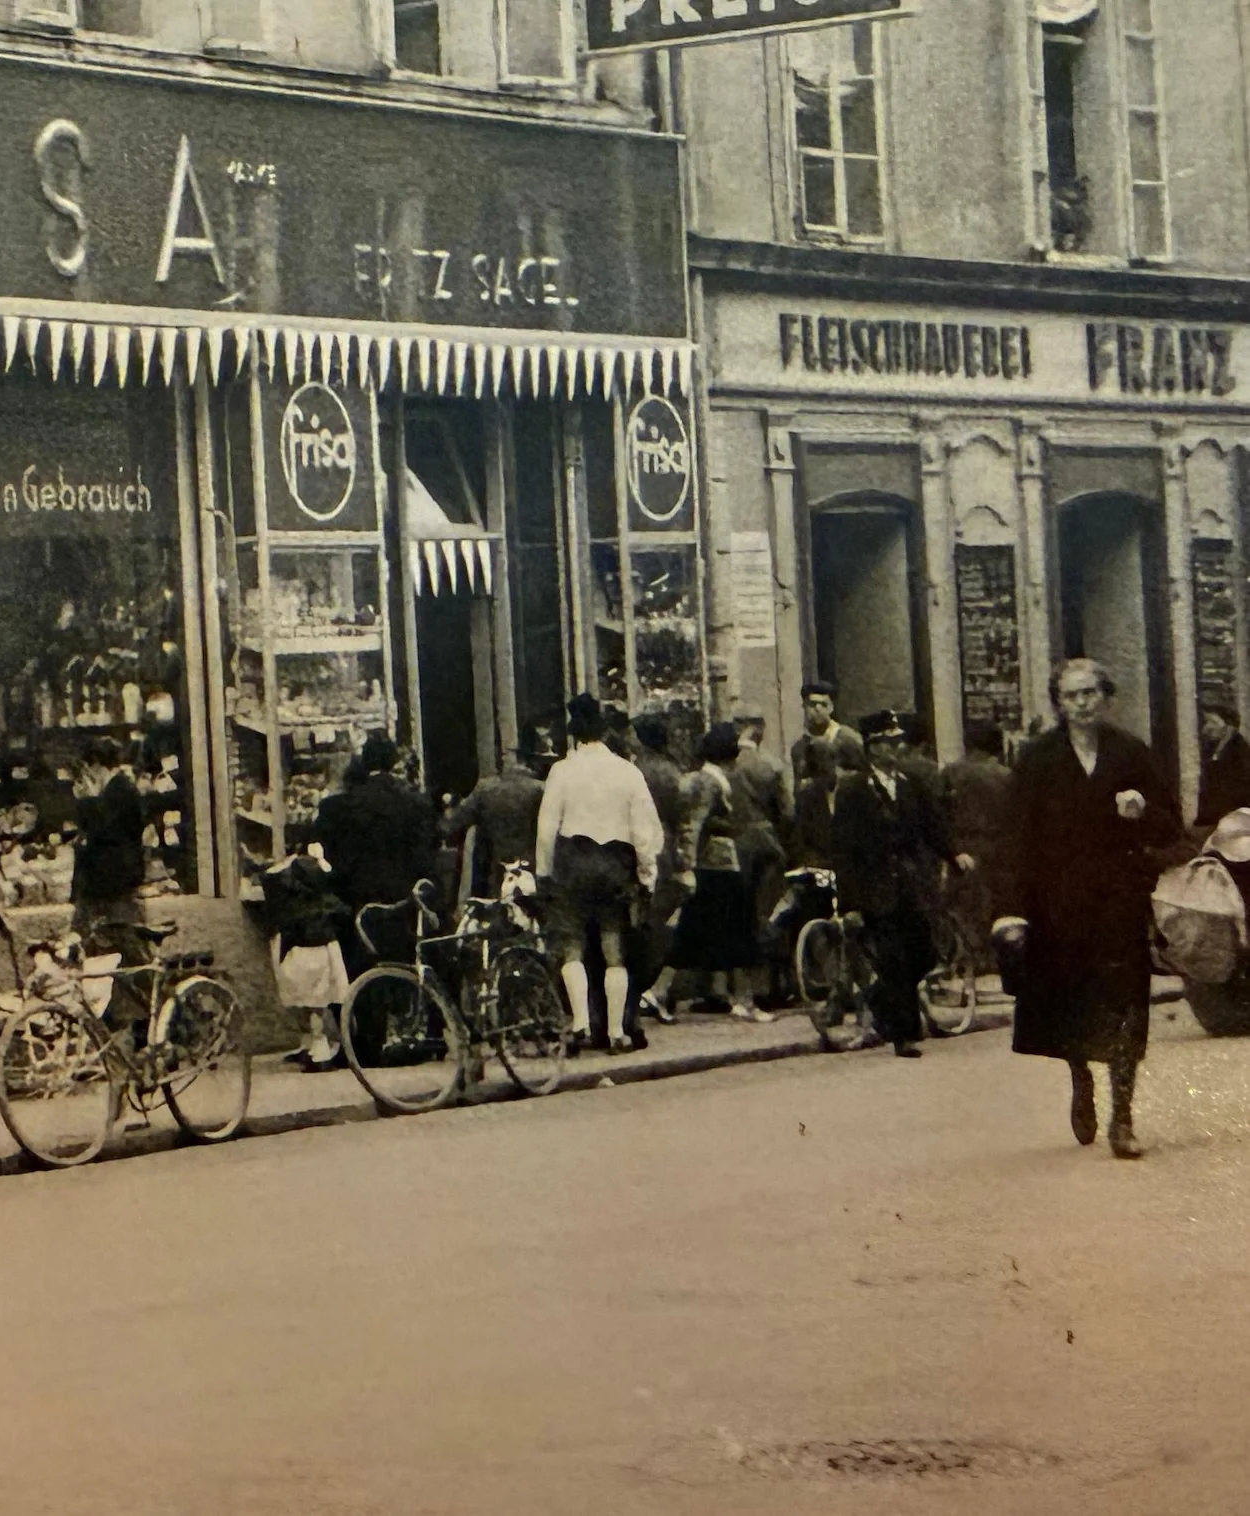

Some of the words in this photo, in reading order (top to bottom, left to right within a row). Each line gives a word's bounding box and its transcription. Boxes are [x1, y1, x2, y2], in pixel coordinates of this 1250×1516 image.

[1086, 323, 1237, 396] FRANZ
[290, 403, 353, 493] frisa
[22, 464, 152, 512] Gebrauch
